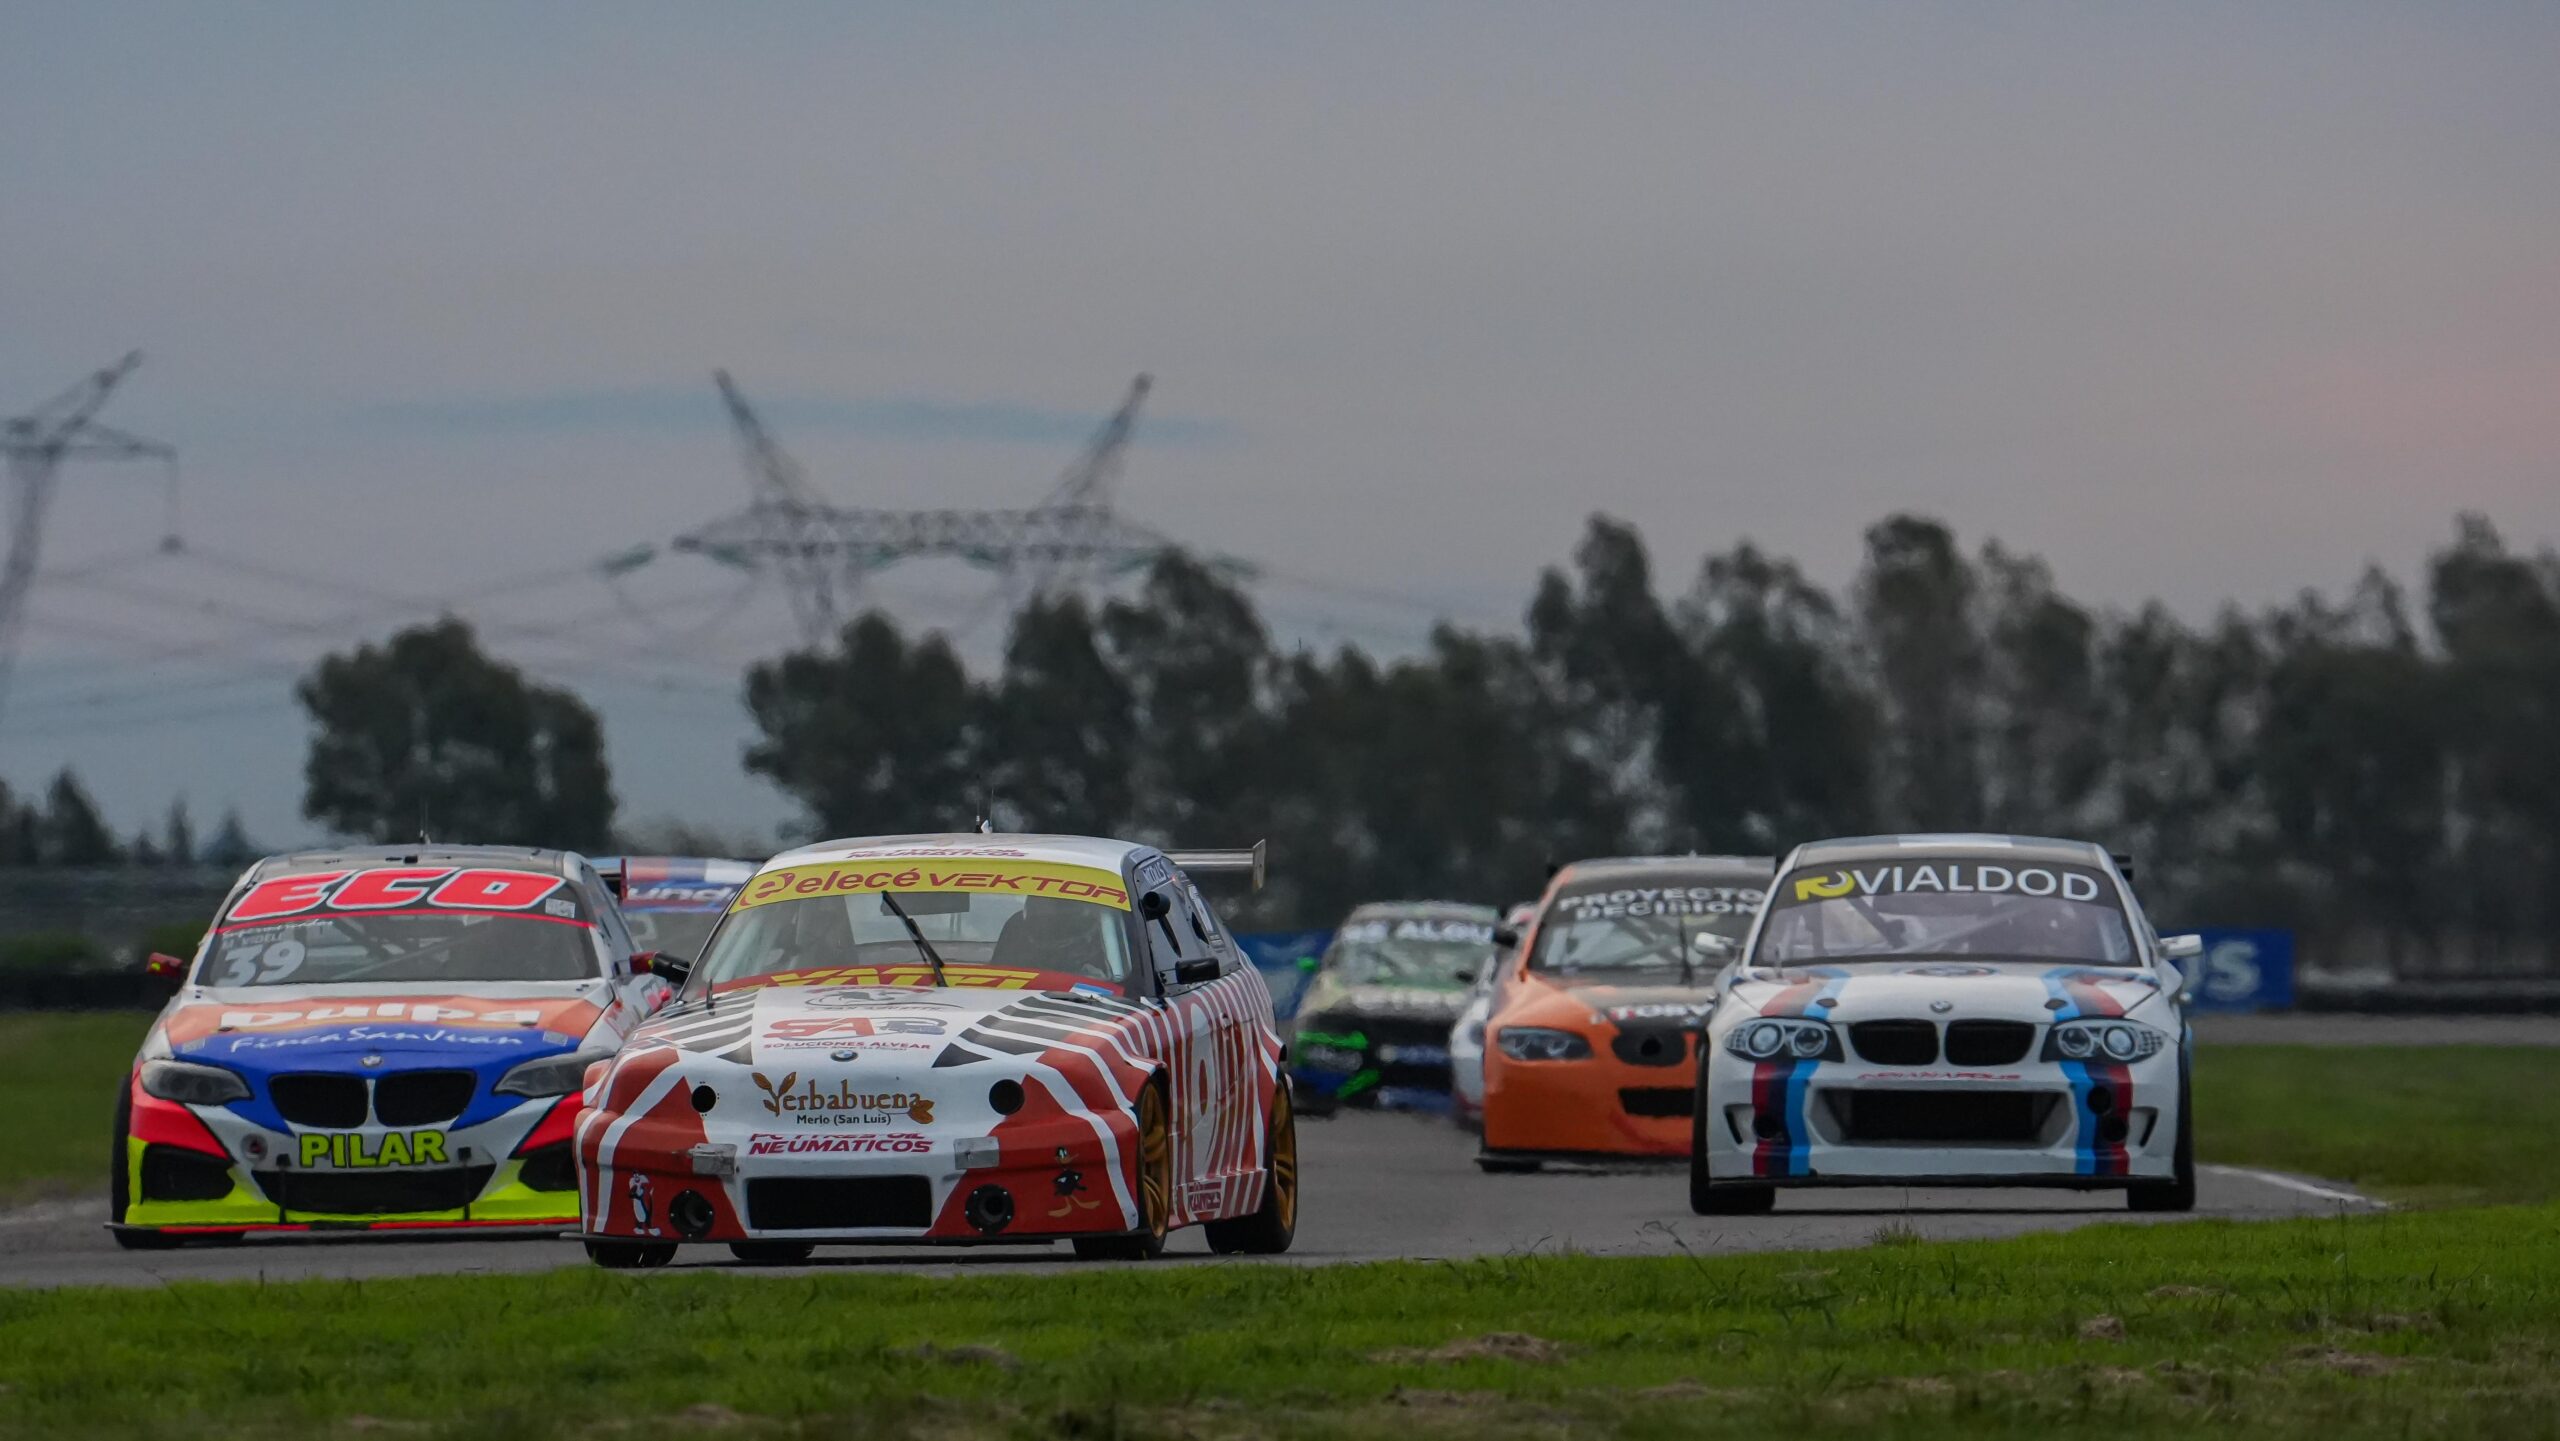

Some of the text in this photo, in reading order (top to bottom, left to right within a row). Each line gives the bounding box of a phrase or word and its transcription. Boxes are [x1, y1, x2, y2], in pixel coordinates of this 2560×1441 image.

[225, 868, 566, 921] ECO
[795, 868, 921, 894] elecé
[929, 873, 1128, 904] VEKTOR
[1852, 865, 2098, 900] VIALDOD
[214, 940, 306, 987] 39
[751, 1071, 922, 1117] Yerbabuena
[796, 1113, 892, 1127] Merlo (San Luis)
[300, 1130, 449, 1168] PILAR
[749, 1139, 935, 1156] NEUMATICOS
